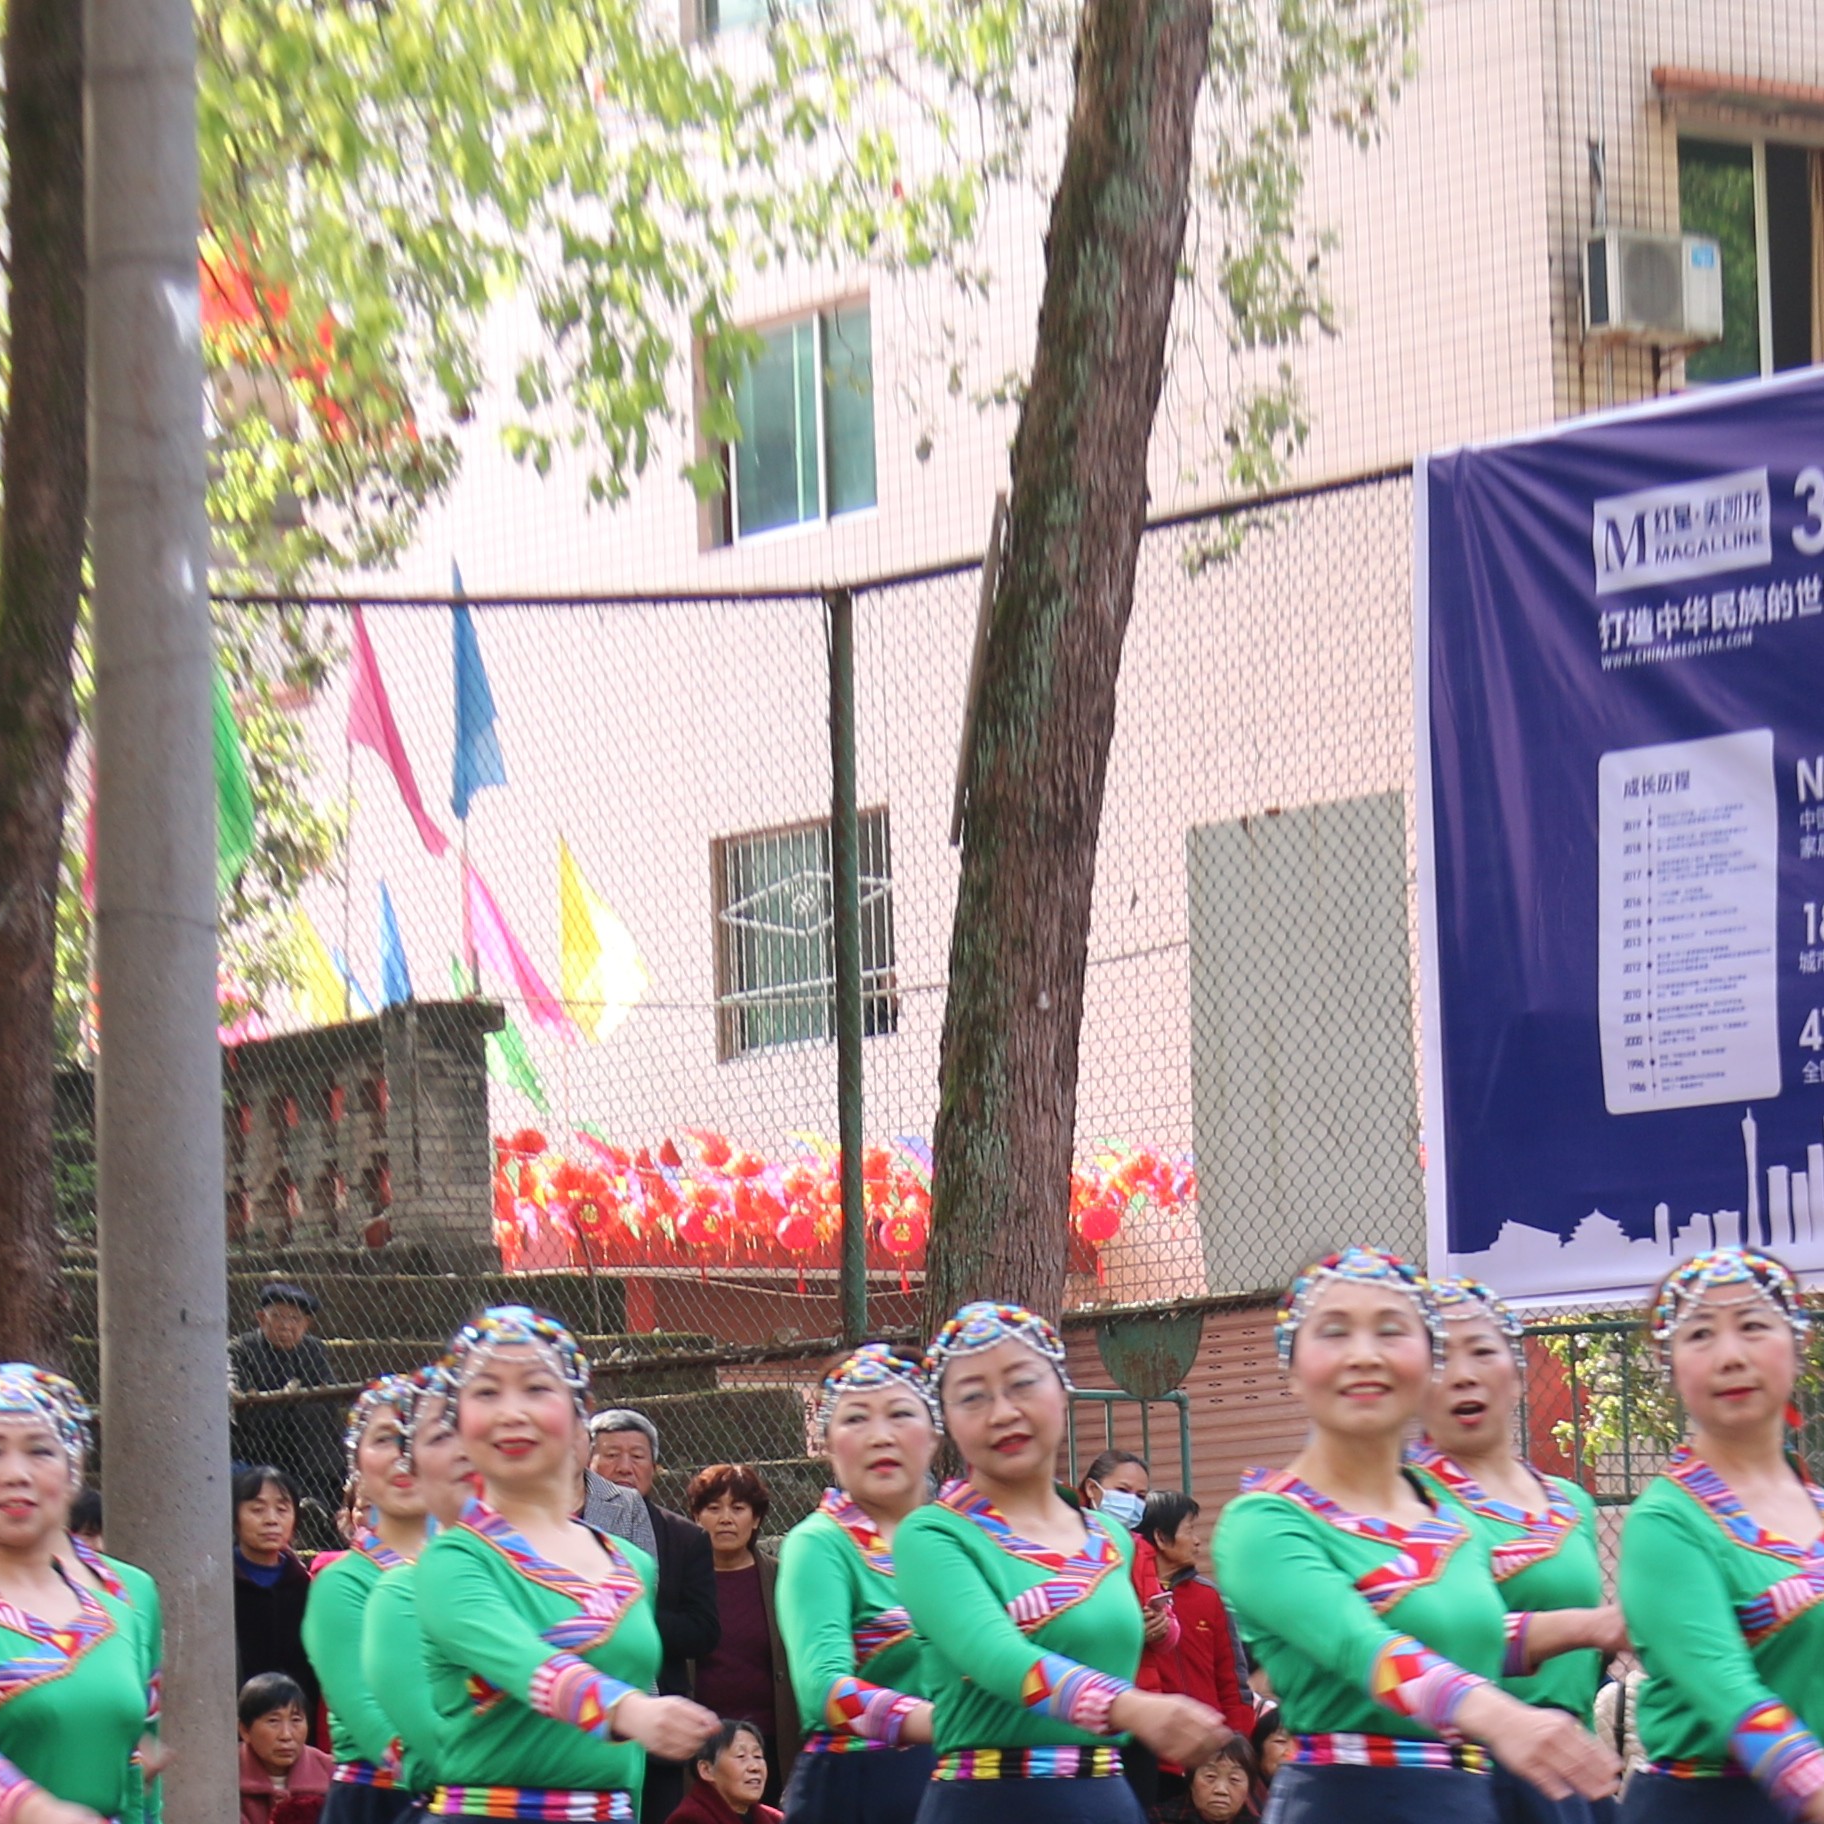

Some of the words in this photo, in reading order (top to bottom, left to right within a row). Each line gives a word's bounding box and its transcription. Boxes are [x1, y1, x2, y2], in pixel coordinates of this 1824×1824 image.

[1655, 529, 1764, 566] MACALLINE
[1624, 769, 1691, 799] 成长历程
